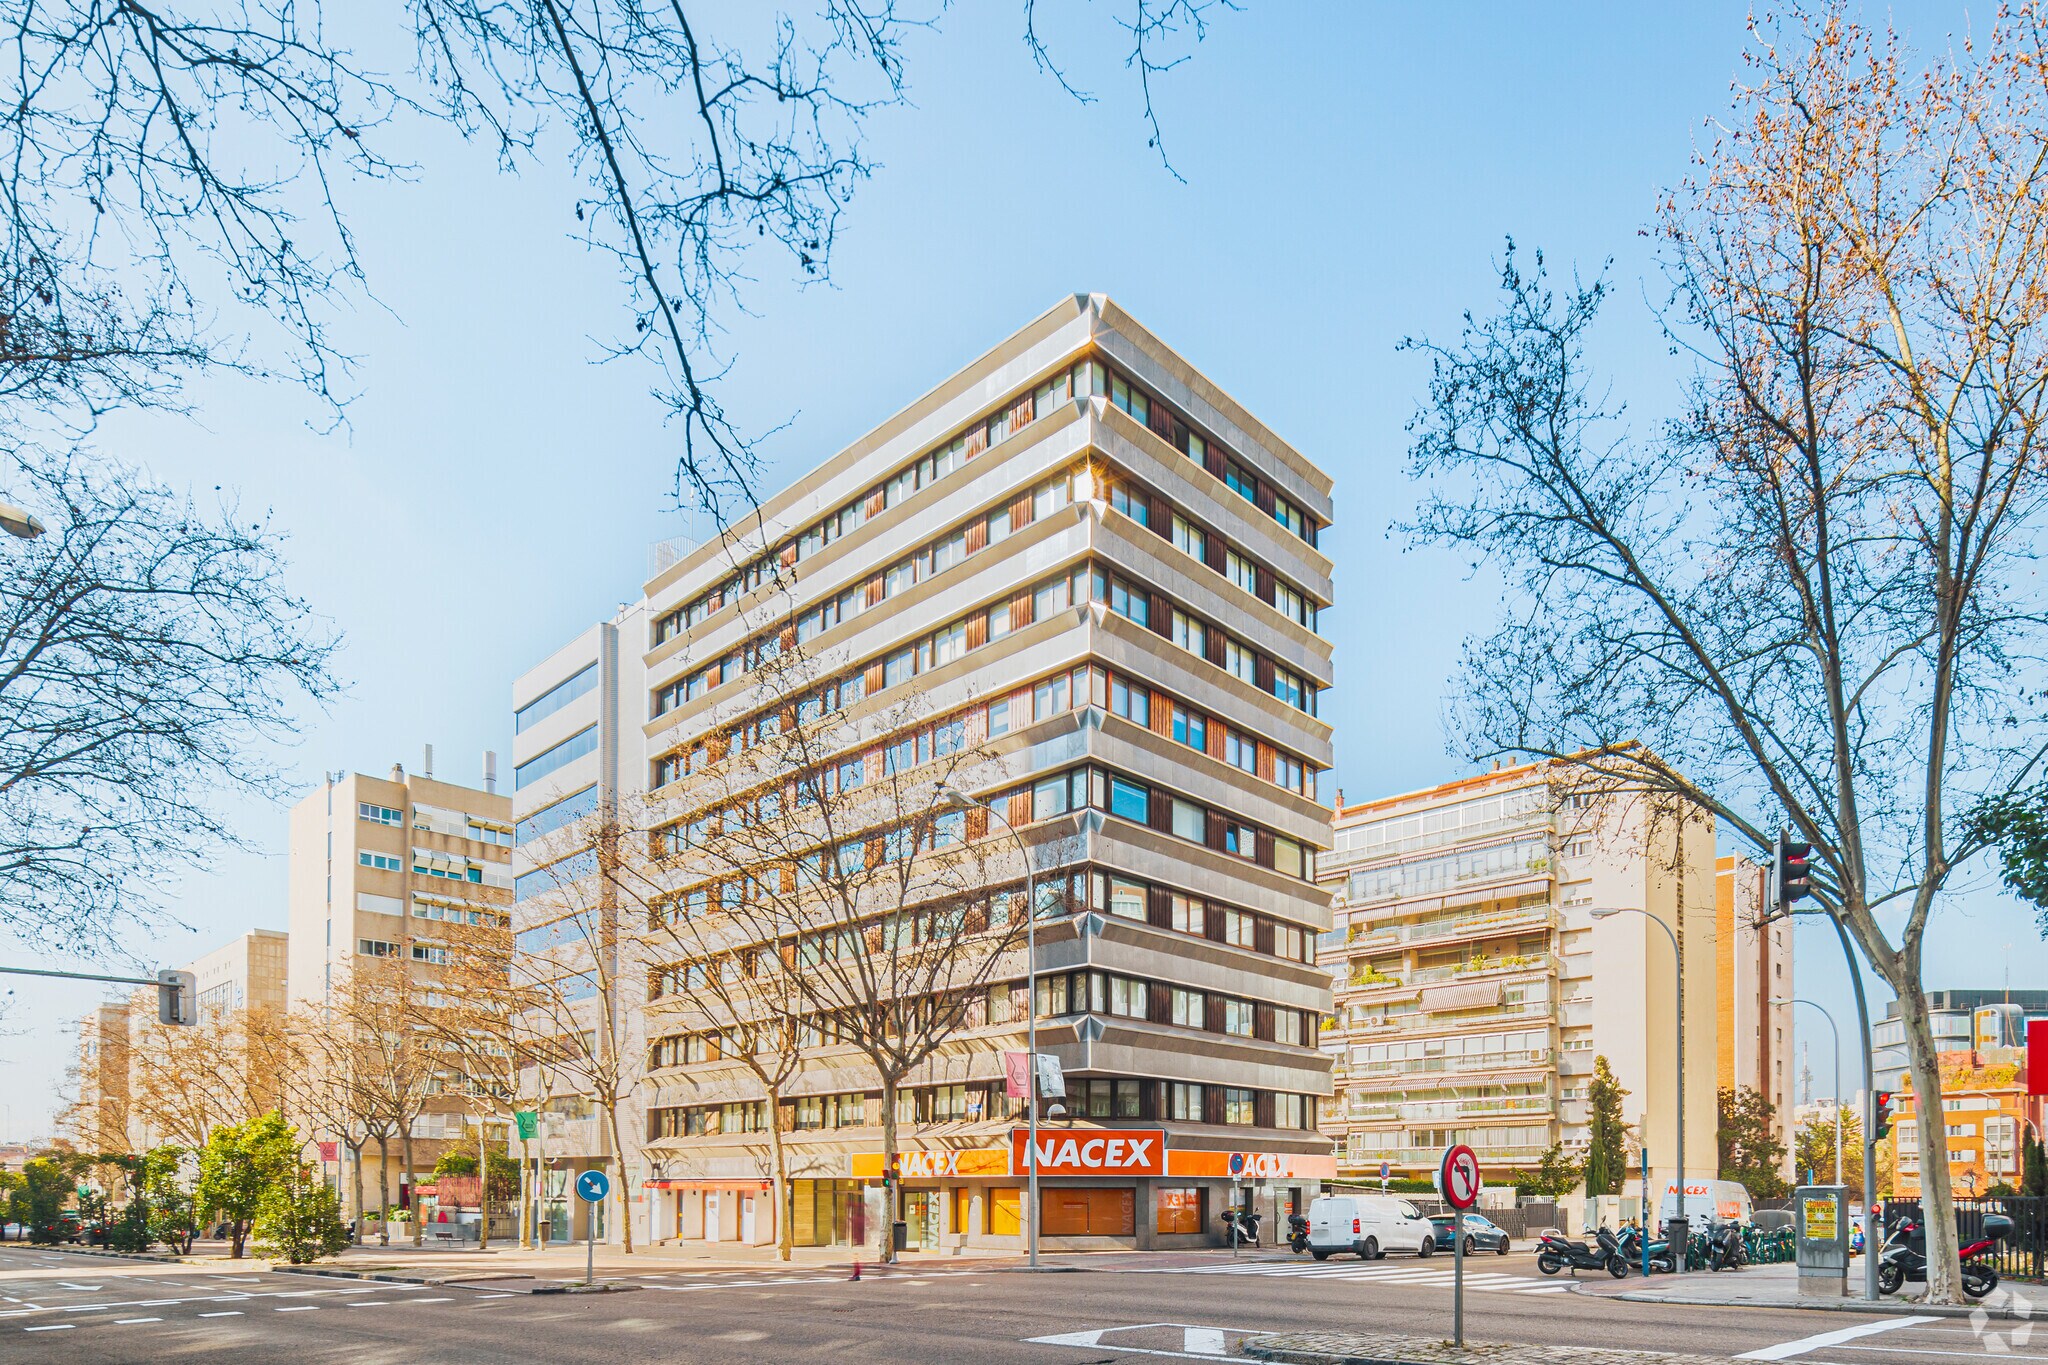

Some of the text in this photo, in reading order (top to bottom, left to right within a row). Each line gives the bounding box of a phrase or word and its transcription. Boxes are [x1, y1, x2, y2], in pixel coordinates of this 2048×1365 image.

[1022, 1138, 1154, 1168] NACEX
[928, 1191, 940, 1250] NACEX
[1121, 1191, 1134, 1233] NACEX
